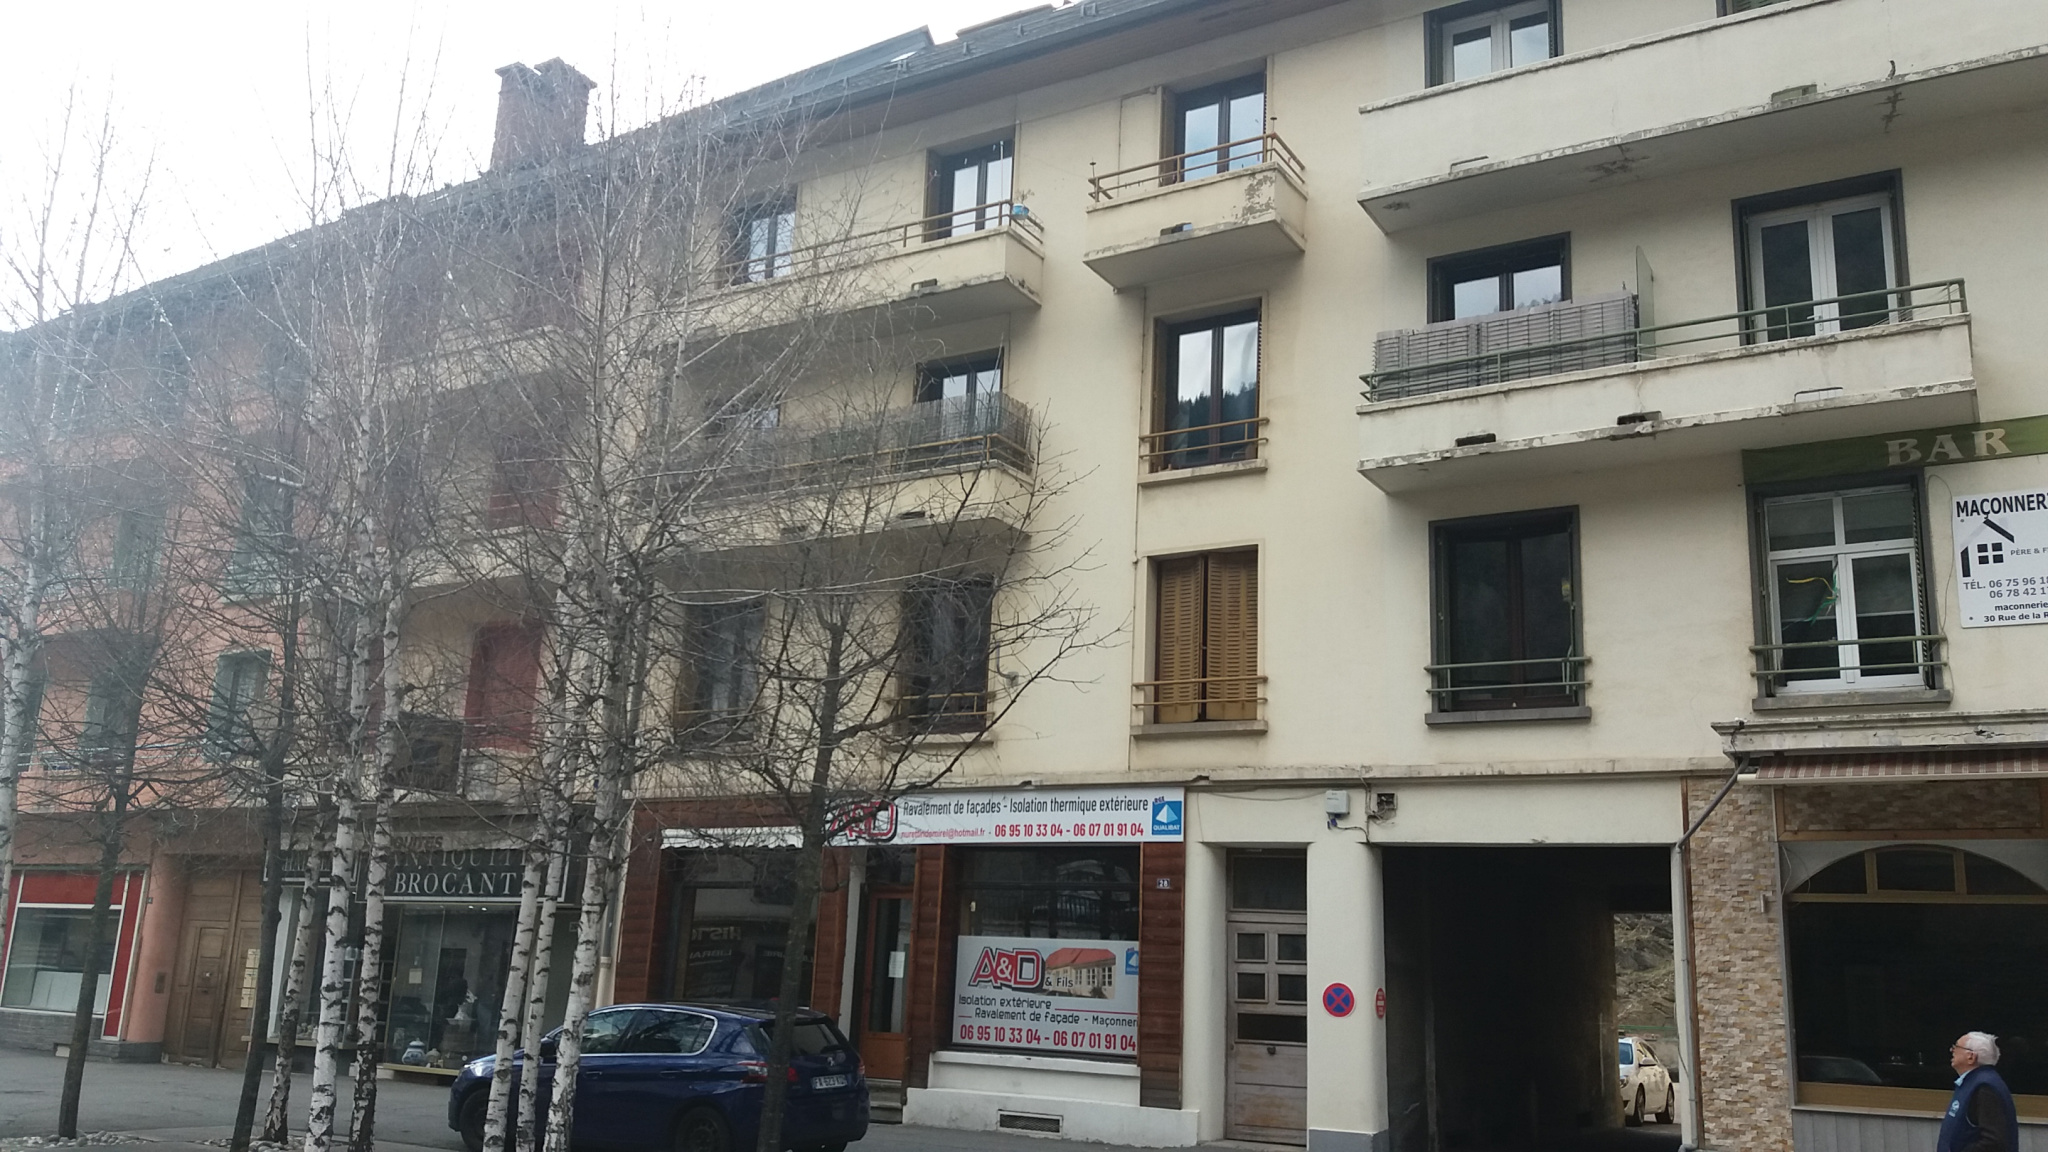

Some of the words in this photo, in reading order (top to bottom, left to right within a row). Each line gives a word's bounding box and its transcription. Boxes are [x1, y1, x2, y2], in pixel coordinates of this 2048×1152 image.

[1886, 428, 2012, 466] BAR
[1956, 493, 2048, 519] MAÇONNER
[2011, 548, 2031, 556] PÈRE
[1963, 579, 1986, 590] TÉL.
[1989, 580, 2002, 588] 06
[2006, 578, 2019, 587] 75
[2022, 577, 2036, 586] 96
[1989, 590, 2003, 599] 06
[2006, 589, 2020, 597] 78
[2023, 588, 2037, 596] 42
[2040, 587, 2048, 595] 1
[903, 801, 951, 816] Ravalement
[954, 800, 964, 814] de
[967, 798, 1000, 817] façades
[1010, 797, 1048, 813] Isolation
[1050, 797, 1096, 815] thermique
[1100, 796, 1148, 811] extérieure
[994, 824, 1006, 837] 06
[1009, 824, 1021, 837] 95
[1024, 824, 1033, 837] 10
[1036, 824, 1047, 837] 33
[1050, 824, 1063, 836] 04
[1073, 823, 1085, 836] 06
[1089, 823, 1100, 836] 07
[1104, 823, 1114, 836] 01
[1117, 823, 1127, 836] 91
[1130, 823, 1144, 836] 04
[393, 872, 524, 894] BROCANT
[968, 947, 1044, 991] A&D
[1045, 977, 1052, 986] &
[1057, 976, 1074, 988] Fils
[959, 994, 997, 1006] Isolation
[1000, 997, 1051, 1010] extérieure
[975, 1007, 1026, 1021] Ravalement
[1029, 1011, 1041, 1021] de
[1045, 1011, 1080, 1025] façade
[960, 1024, 974, 1040] 06
[977, 1025, 991, 1041] 95
[994, 1026, 1005, 1042] 10
[1009, 1027, 1022, 1043] 33
[1026, 1028, 1041, 1045] 04
[1053, 1030, 1068, 1046] 06
[1071, 1031, 1086, 1048] 07
[1089, 1032, 1101, 1049] 01
[1105, 1033, 1117, 1050] 91
[1120, 1034, 1136, 1051] 04
